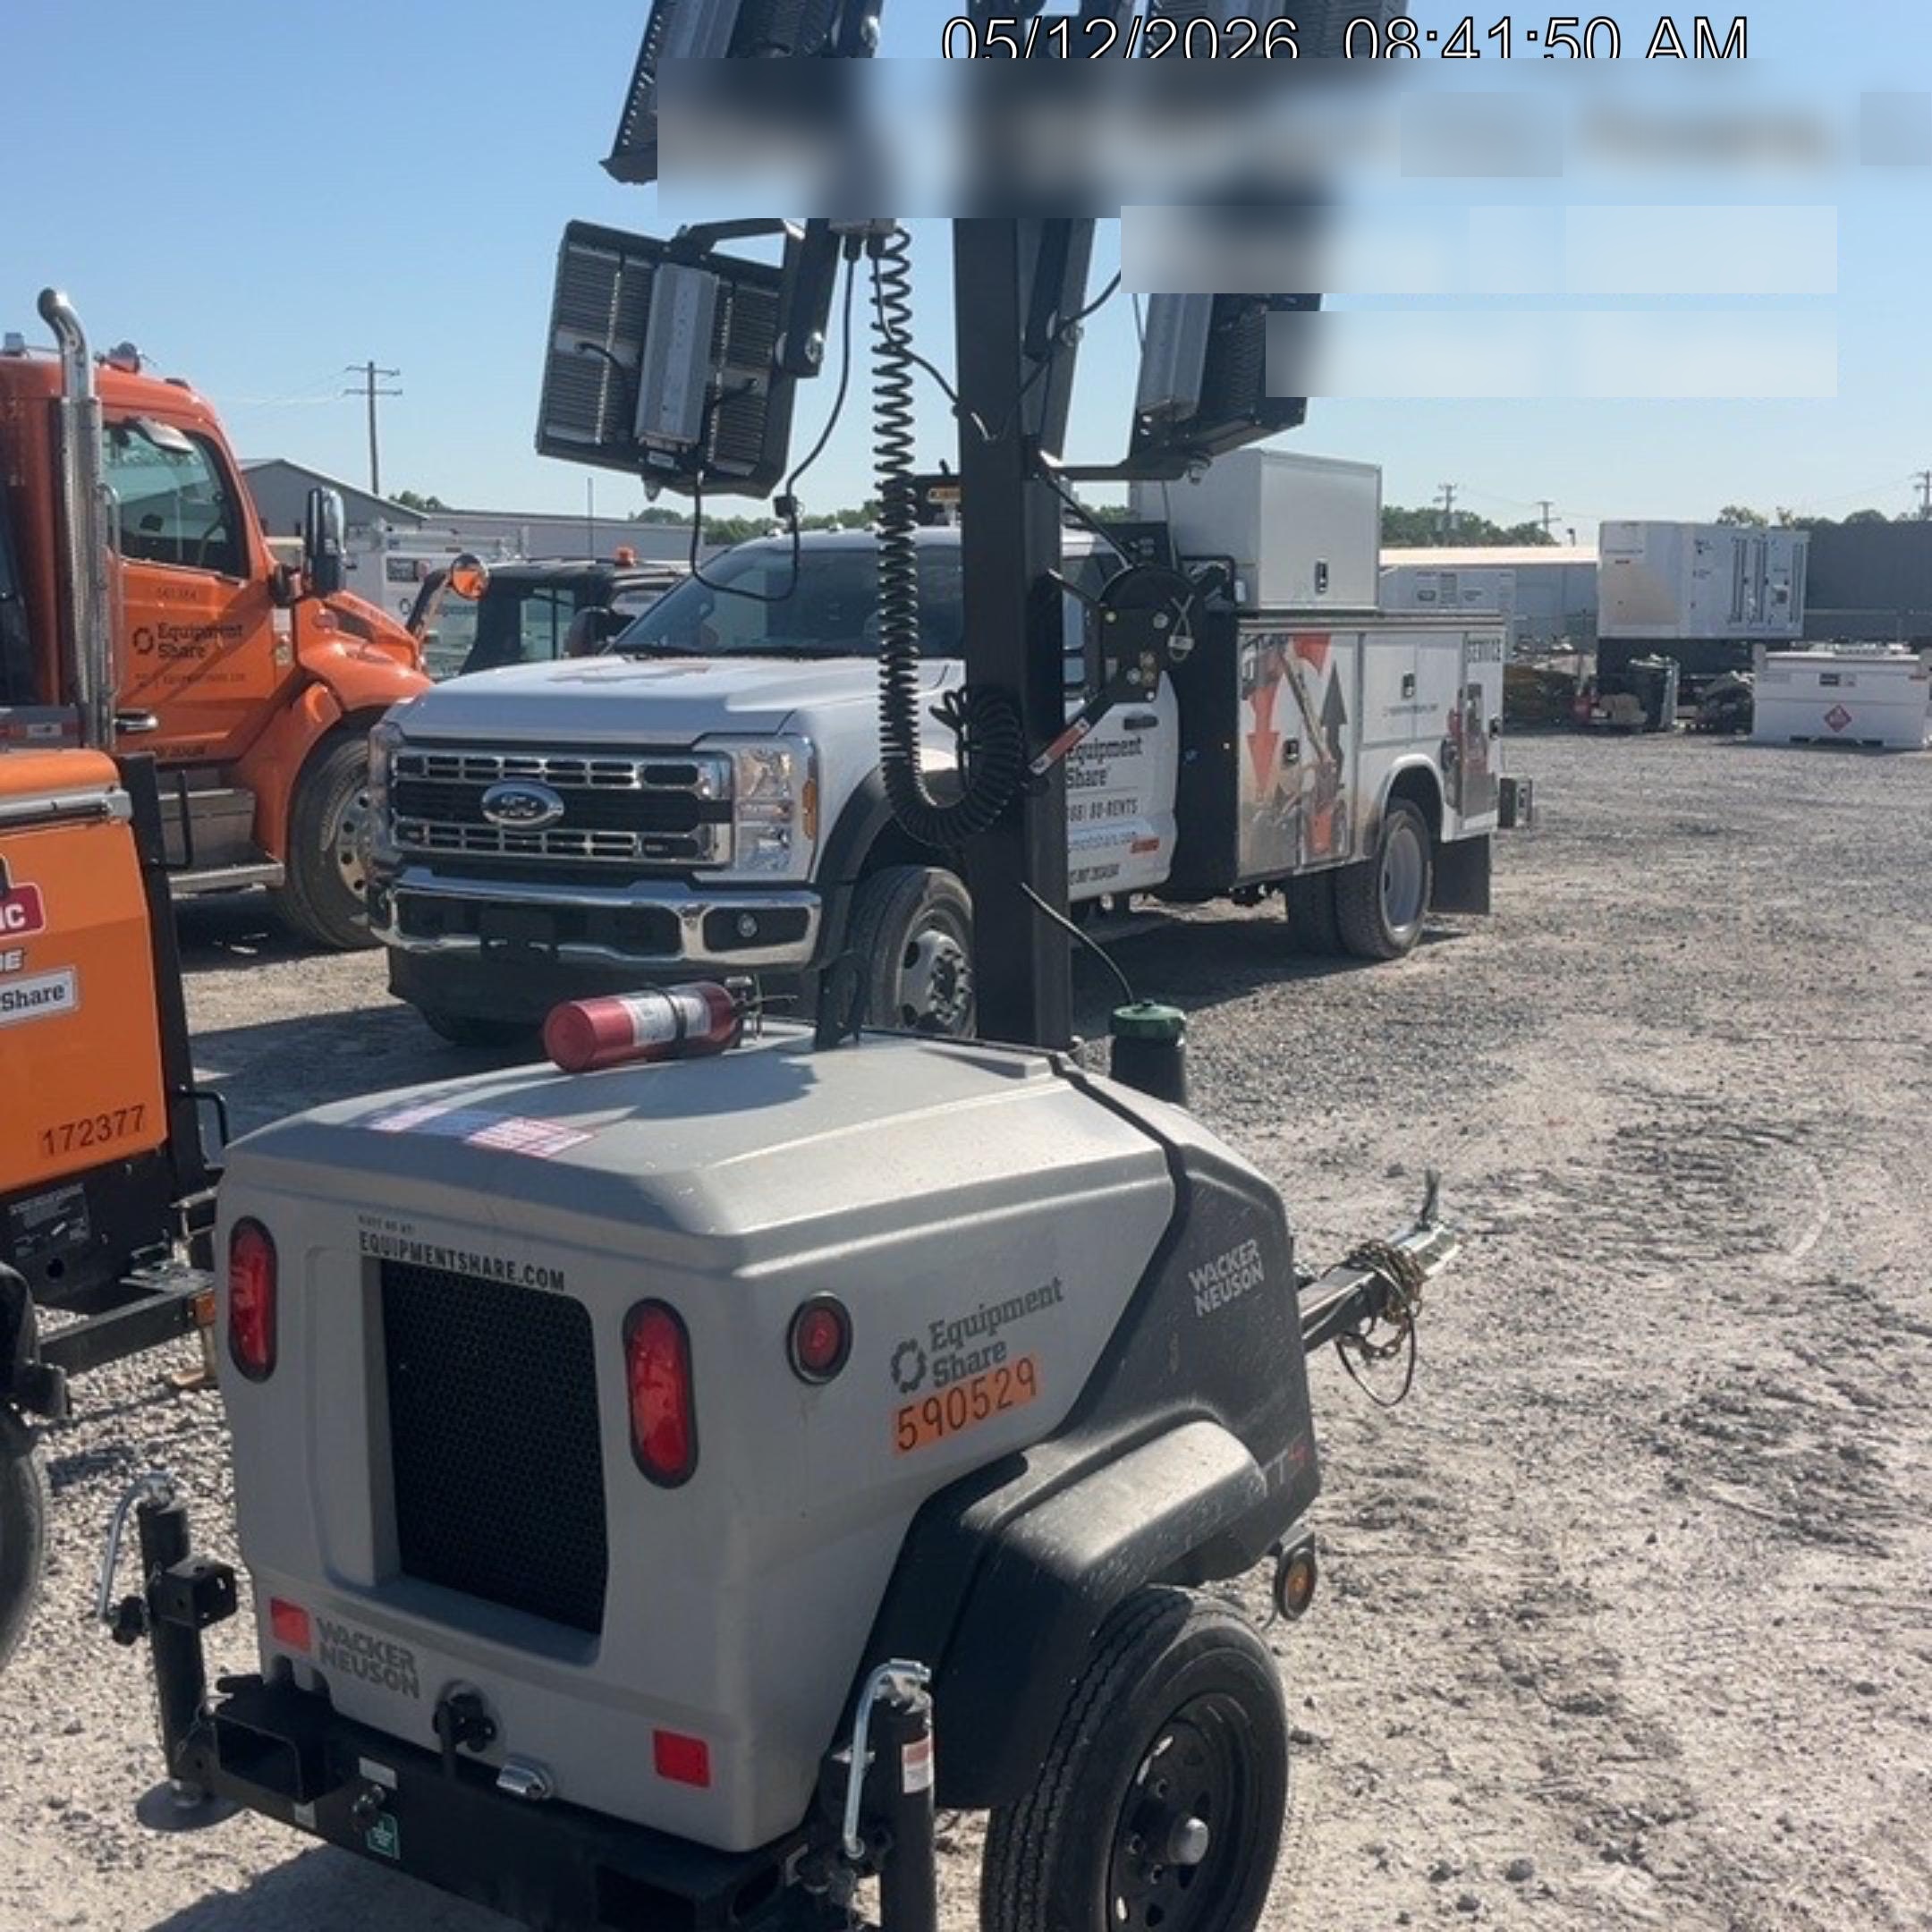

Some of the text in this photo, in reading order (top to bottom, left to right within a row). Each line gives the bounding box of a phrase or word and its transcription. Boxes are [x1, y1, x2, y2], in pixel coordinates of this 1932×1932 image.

[42, 1105, 146, 1157] 172377
[359, 1231, 564, 1292] EQUIPMENTSHARE.COM
[1188, 1238, 1258, 1292] WACKER
[1194, 1259, 1264, 1318] NEUSON
[928, 1276, 1063, 1351] Equipment
[932, 1340, 1007, 1387] Share
[897, 1357, 1037, 1451] 590529
[315, 1617, 415, 1674] WACKER
[319, 1642, 420, 1699] NEUSON
